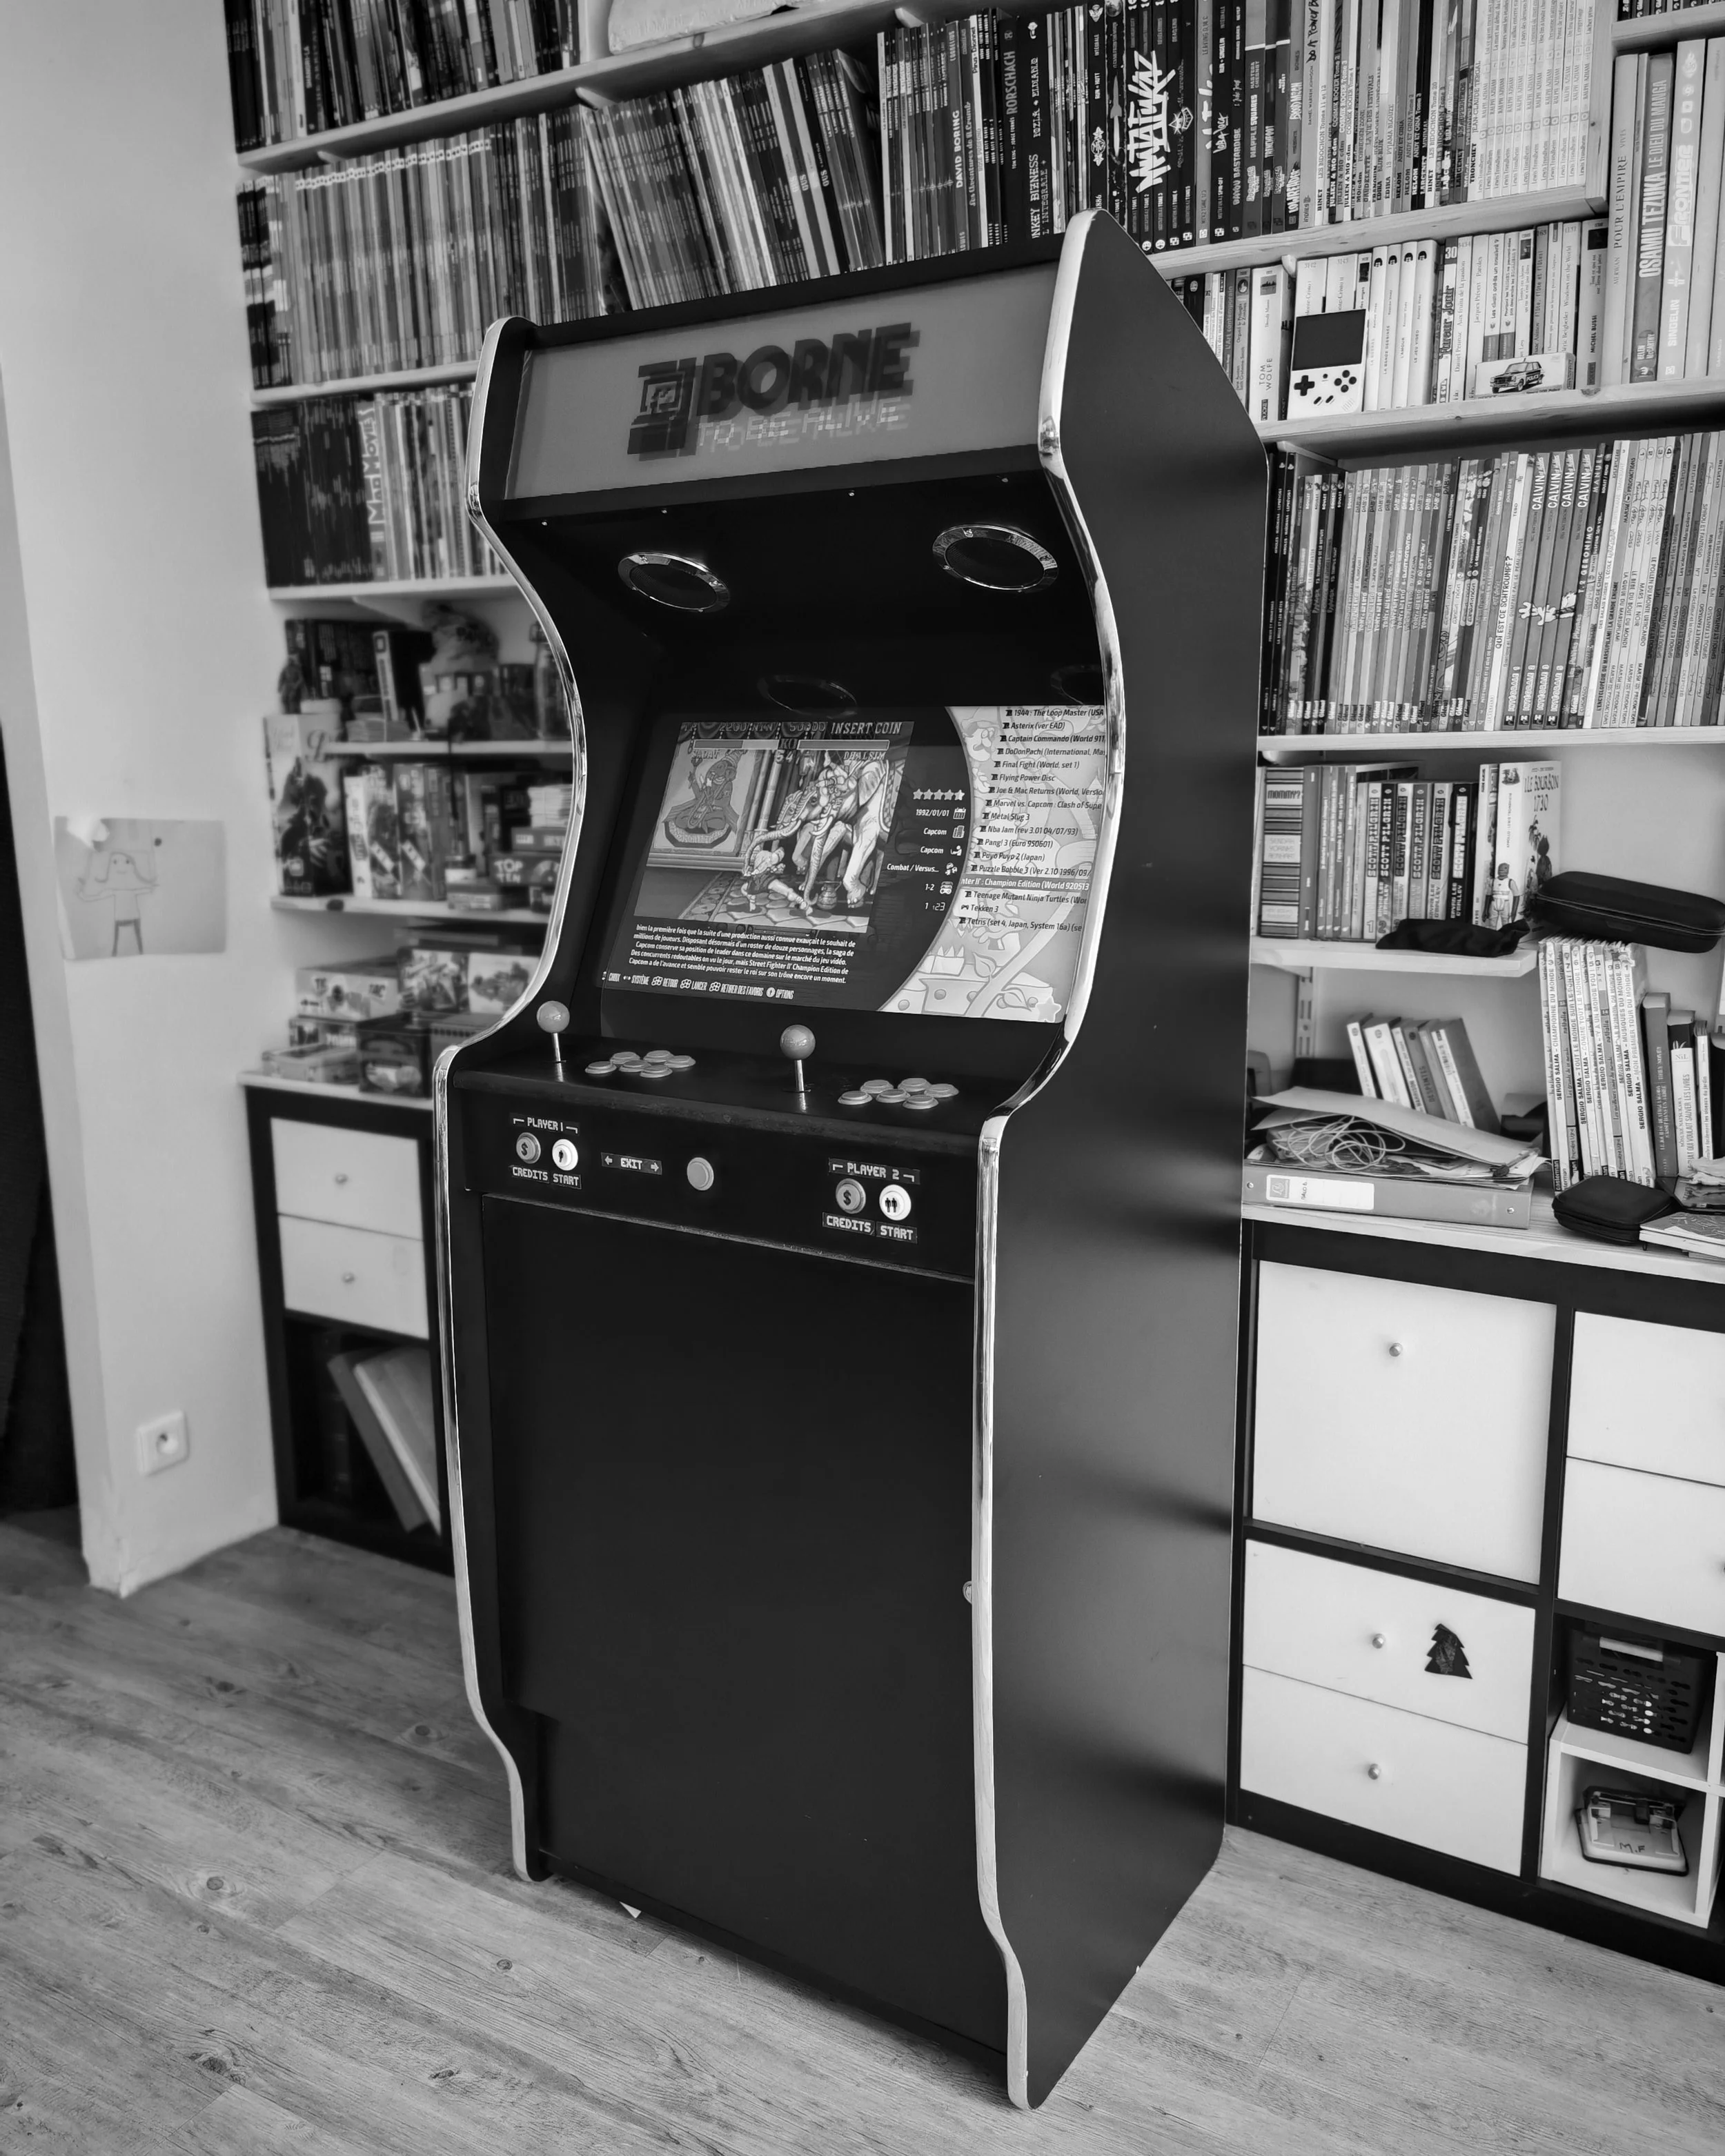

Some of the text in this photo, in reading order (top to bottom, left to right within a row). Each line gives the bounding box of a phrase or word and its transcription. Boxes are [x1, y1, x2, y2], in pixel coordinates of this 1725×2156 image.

[1003, 50, 1018, 115] RORSCHACH
[1650, 79, 1666, 115] MANGA
[1472, 88, 1480, 132] JEAN-CLAUDE
[1649, 118, 1664, 130] DU
[952, 110, 963, 188] DAVID BORING
[1648, 132, 1664, 155] DIEU
[1647, 155, 1662, 168] LE
[1029, 154, 1039, 201] BIZNESS
[1232, 180, 1241, 205] BAYOU
[1286, 168, 1300, 213] LOWREADER
[1613, 155, 1627, 248] POUR L'EMPIRE
[1445, 246, 1457, 259] 30
[1639, 226, 1662, 278] OSAMU
[1667, 299, 1680, 346] SINGELIN
[697, 322, 914, 418] BORNE
[1532, 475, 1545, 510] CALVIN
[1548, 473, 1561, 508] CALVIN
[1561, 472, 1575, 507] CALVIN
[1577, 473, 1591, 507] CALVIN
[1580, 526, 1593, 575] GERONIMO
[1498, 609, 1506, 618] CE
[1496, 620, 1504, 633] EST
[1602, 631, 1612, 664] MARSUPILAMI
[1608, 600, 1616, 620] GRANDE
[1046, 709, 1063, 717] Loop
[830, 722, 902, 735] INSERT COIN
[916, 809, 949, 817] 1992/01/01
[1009, 813, 1025, 821] Slug
[923, 827, 947, 836] Capcom
[1043, 827, 1078, 835] 04/07/93)
[920, 846, 944, 855] Capcom
[494, 858, 523, 872] TOP
[887, 863, 909, 871] Combat
[1367, 844, 1378, 877] SCOTT
[1381, 844, 1390, 877] SCOTT
[1412, 845, 1422, 878] SCOTT
[1431, 845, 1443, 879] SCOTT
[925, 883, 934, 891] 1-2
[984, 879, 1016, 888] Champion
[1041, 881, 1065, 889] (World
[974, 892, 1000, 900] Teenage
[1025, 894, 1044, 902] Ninja
[635, 941, 655, 949] Capcom
[685, 945, 707, 954] position
[820, 956, 829, 965] jeu
[1550, 993, 1556, 1002] DU
[1550, 1004, 1559, 1047] CHAMPIONNE
[527, 1117, 558, 1131] PLAYER
[620, 1158, 642, 1170] EXIT
[847, 1163, 900, 1180] PLAYER 2
[512, 1167, 549, 1181] CREDITS
[553, 1174, 579, 1186] START
[826, 1215, 871, 1233] CREDITS
[880, 1225, 914, 1240] START
